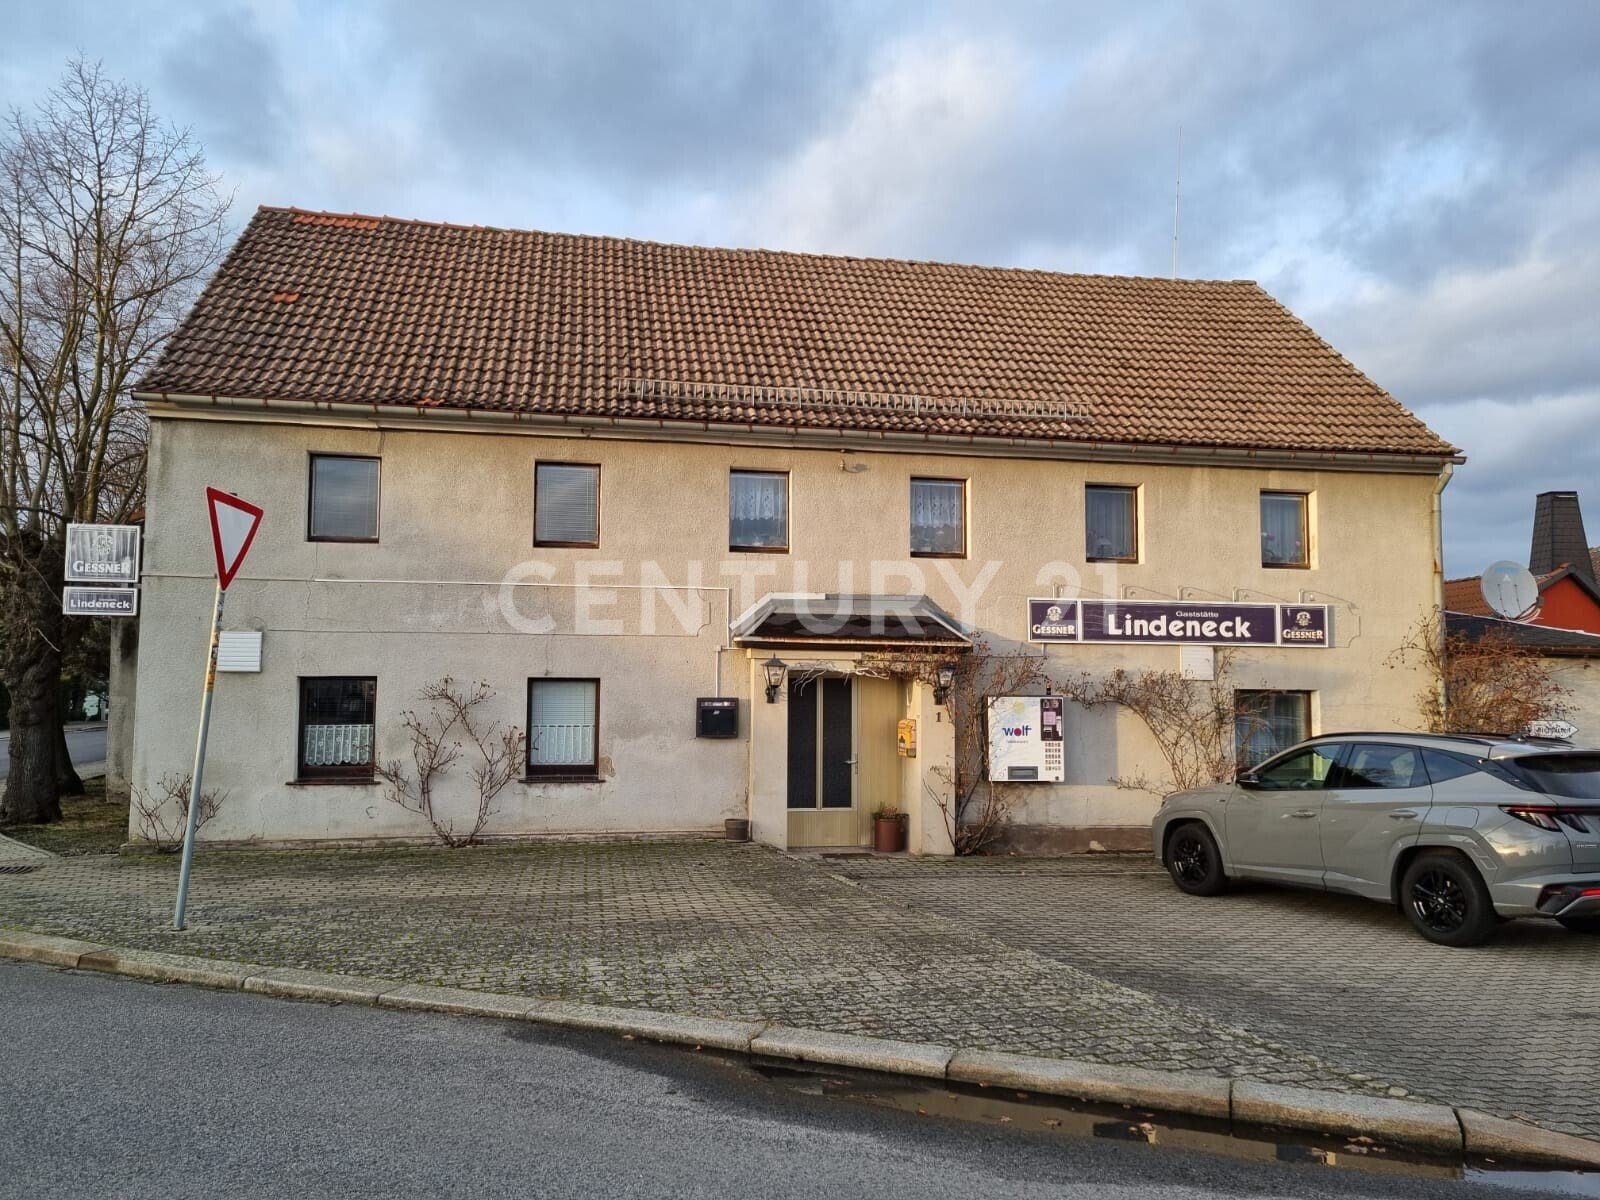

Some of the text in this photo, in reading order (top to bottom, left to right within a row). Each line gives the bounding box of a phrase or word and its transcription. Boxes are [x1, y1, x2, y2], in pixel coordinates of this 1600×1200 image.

[72, 560, 131, 574] GESSNER
[70, 599, 130, 609] Lindeneck
[1175, 610, 1219, 618] Gaststätte
[1032, 624, 1075, 635] GESSNER
[1108, 613, 1252, 638] Lindeneck
[1282, 629, 1324, 640] GESSNER
[936, 711, 942, 722] 1
[1001, 725, 1032, 736] wolf
